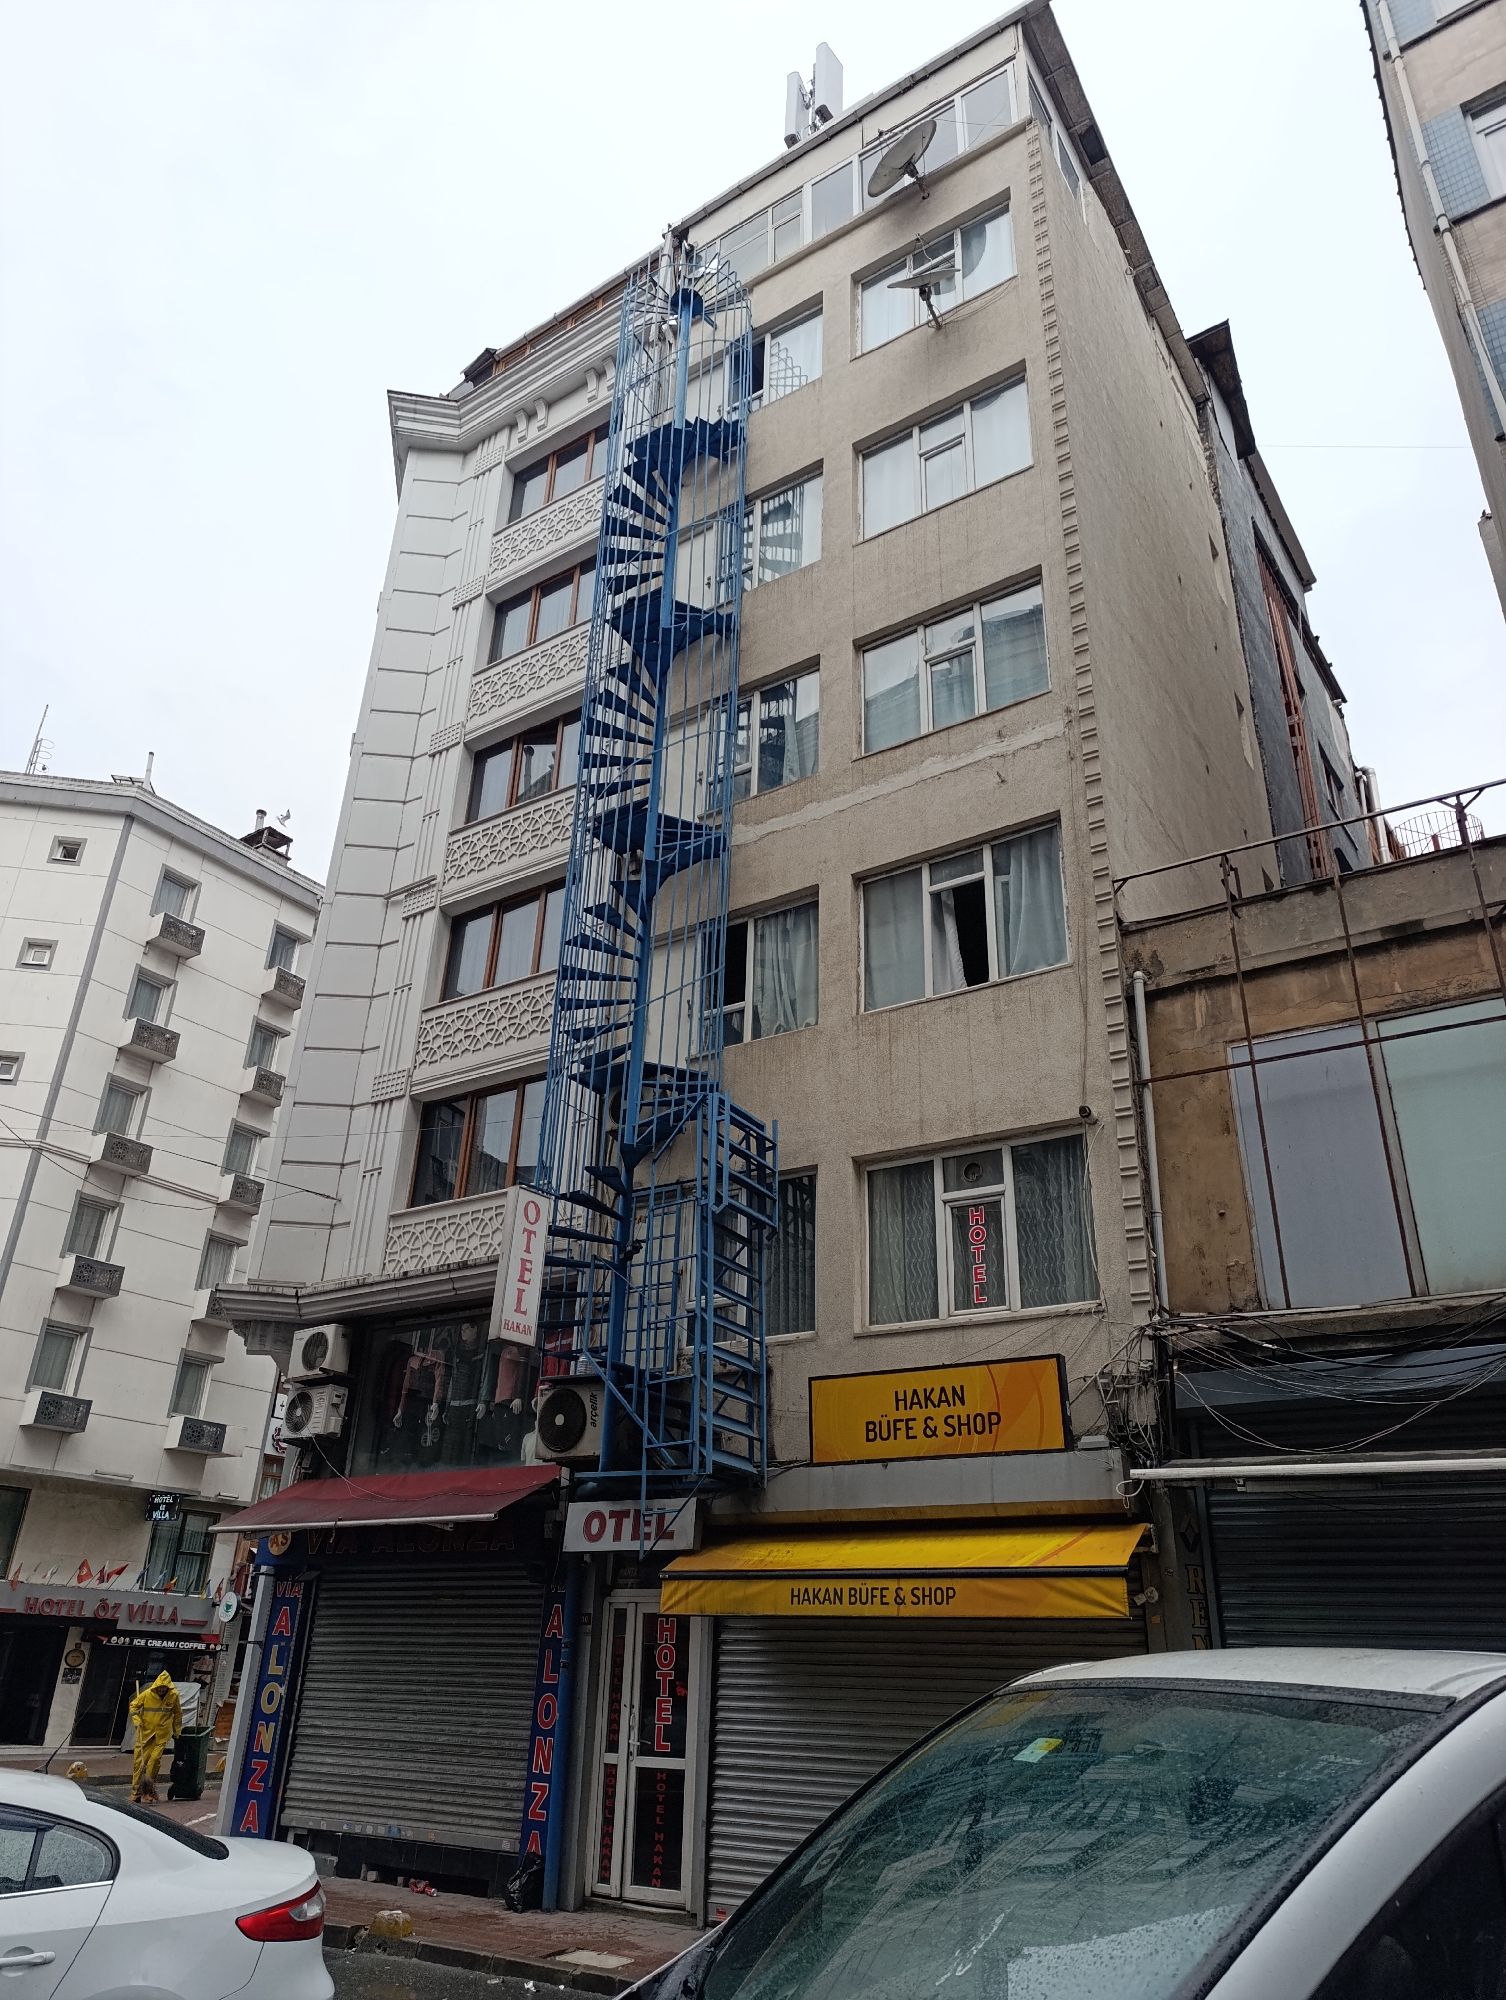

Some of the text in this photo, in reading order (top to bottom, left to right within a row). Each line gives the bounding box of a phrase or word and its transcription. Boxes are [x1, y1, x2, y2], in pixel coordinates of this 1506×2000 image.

[513, 1200, 541, 1316] OTEL
[969, 1205, 987, 1304] HOTEL
[503, 1319, 533, 1336] HAKAN
[589, 1392, 599, 1428] arçelik
[894, 1384, 966, 1411] HAKAN
[865, 1411, 1002, 1443] BÜFE & SHOP
[372, 1522, 515, 1552] ALONZA
[582, 1508, 675, 1543] OTEL
[25, 1597, 87, 1617] HOTEL
[790, 1582, 956, 1606] HAKAN BÜFE & SHOP
[133, 1638, 146, 1646] ICE
[654, 1617, 677, 1753] HOTEL
[240, 1606, 290, 1834] ALONZA
[526, 1603, 563, 1856] ALONZA
[609, 1692, 621, 1741] HAKAN
[601, 1763, 617, 1878] HOTEL HAKAN
[650, 1772, 667, 1887] HOTEL HAKAN
